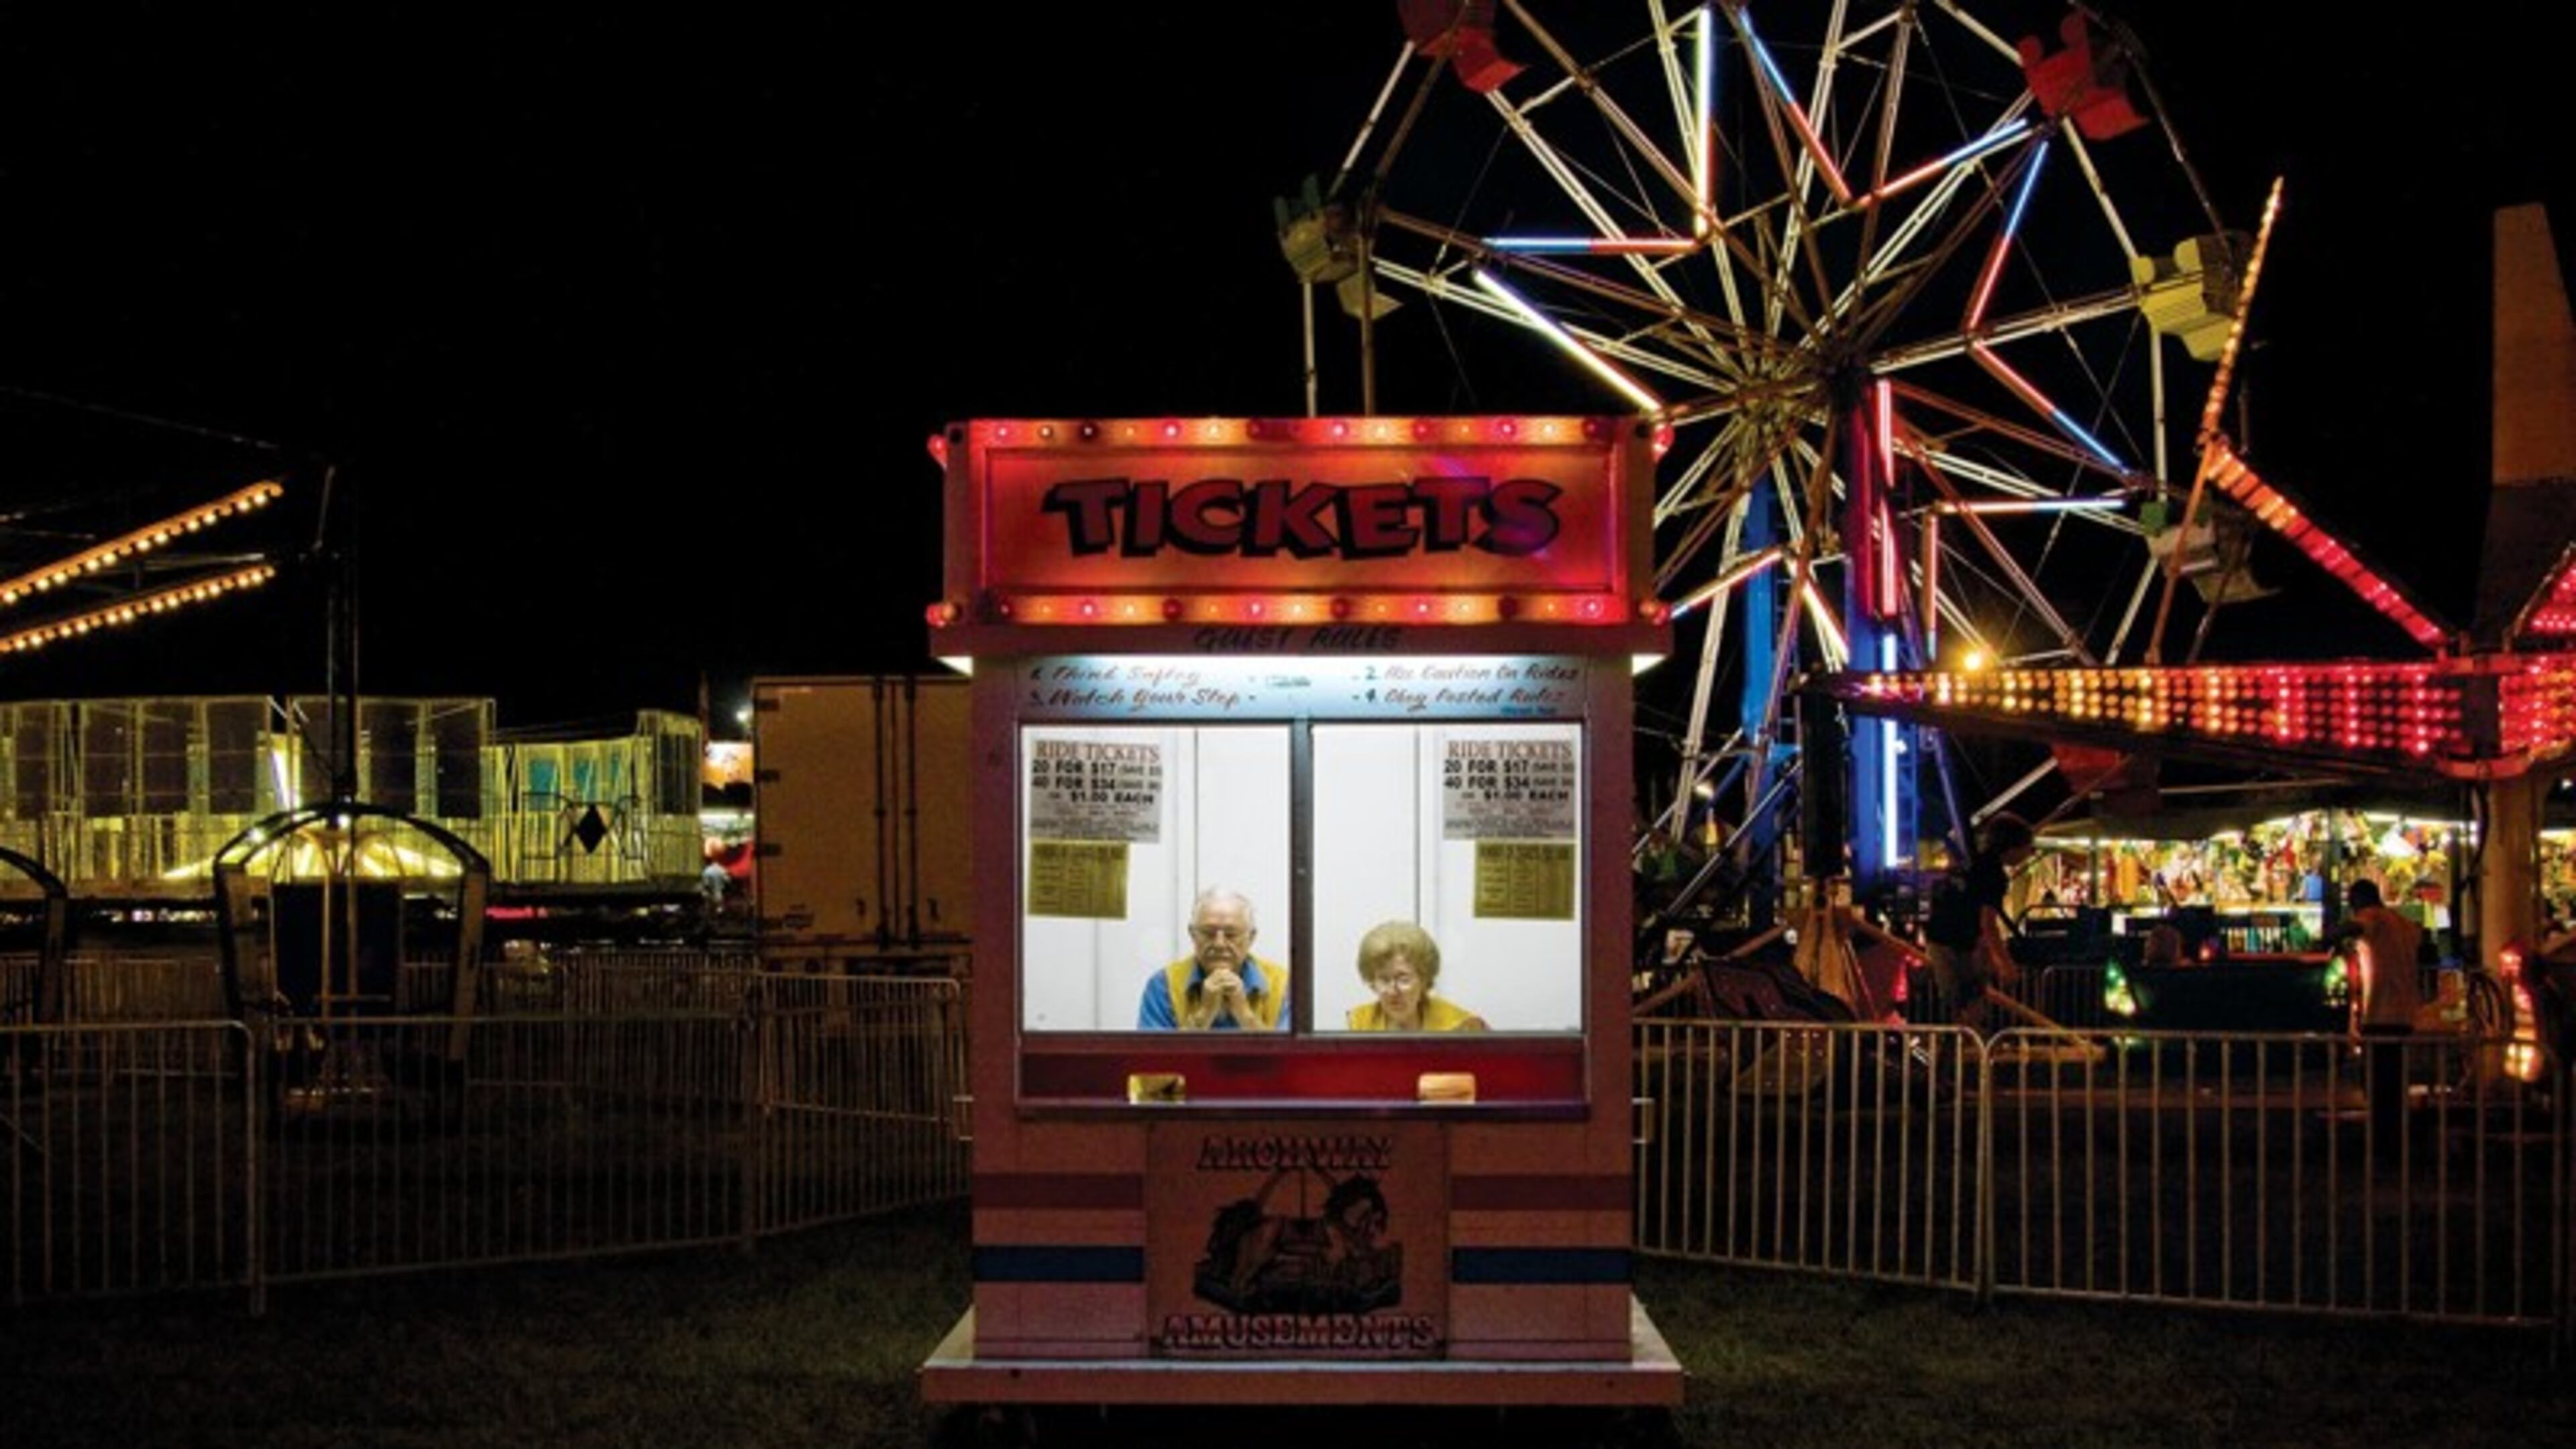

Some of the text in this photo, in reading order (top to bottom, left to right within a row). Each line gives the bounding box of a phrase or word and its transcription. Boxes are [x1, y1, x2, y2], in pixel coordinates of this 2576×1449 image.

[1042, 477, 1562, 559] TICKETS
[1195, 627, 1401, 651] GUEST RULES
[1053, 666, 1119, 680] Think
[1421, 665, 1491, 680] Caution
[1524, 663, 1578, 680] Rides
[1049, 689, 1125, 706] Watch
[1191, 688, 1240, 711] Step
[1384, 688, 1428, 711] Obey
[1436, 688, 1503, 703] Posted
[1036, 741, 1160, 763] RIDE TICKETS
[1449, 741, 1572, 760] RIDE TICKETS
[1032, 759, 1050, 773] 20
[1055, 759, 1083, 773] FOR
[1091, 761, 1116, 775] $17
[1444, 759, 1462, 773] 20
[1468, 759, 1497, 773] FOR
[1503, 759, 1528, 773] $17
[1031, 775, 1050, 790] 40
[1055, 775, 1083, 790] FOR
[1091, 777, 1116, 790] $34
[1444, 775, 1462, 790] 40
[1468, 775, 1497, 789] FOR
[1505, 775, 1530, 790] $34
[1071, 790, 1108, 803] $1.00
[1114, 791, 1153, 804] EACH
[1485, 790, 1523, 802] $1.00
[1529, 790, 1569, 802] EACH
[1163, 1313, 1436, 1350] AMUSEMENTS
